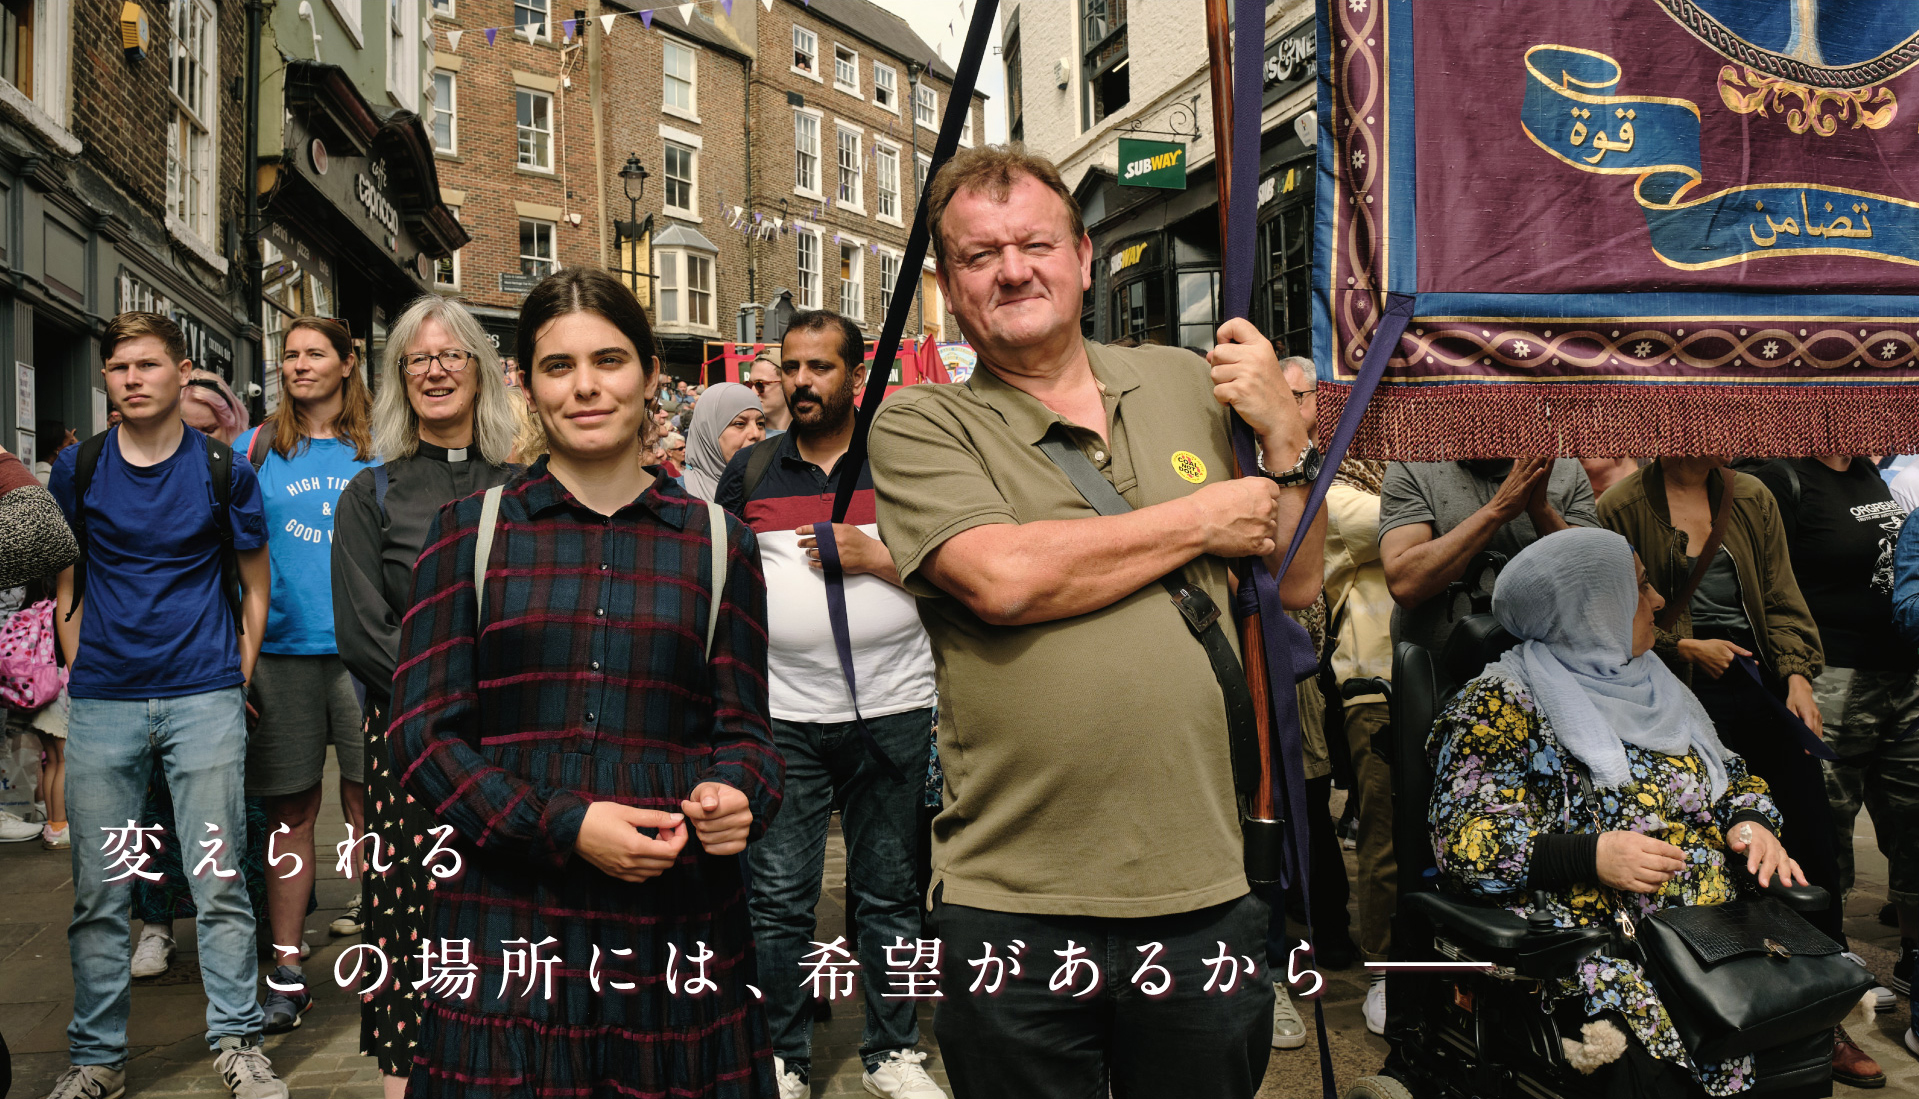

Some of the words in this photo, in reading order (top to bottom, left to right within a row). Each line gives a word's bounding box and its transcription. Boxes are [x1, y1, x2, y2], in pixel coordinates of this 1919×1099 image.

[1570, 106, 1636, 164] قوة
[1124, 149, 1183, 179] SUBWAY
[1750, 190, 1873, 247] تضامن
[1109, 242, 1147, 277] SUBWAY
[1178, 457, 1197, 468] COAL
[1179, 466, 1199, 477] DOLE
[1182, 463, 1195, 471] NOT
[286, 477, 320, 497] HIGH
[327, 477, 350, 491] TID
[322, 501, 332, 516] &
[285, 519, 321, 543] GOOD
